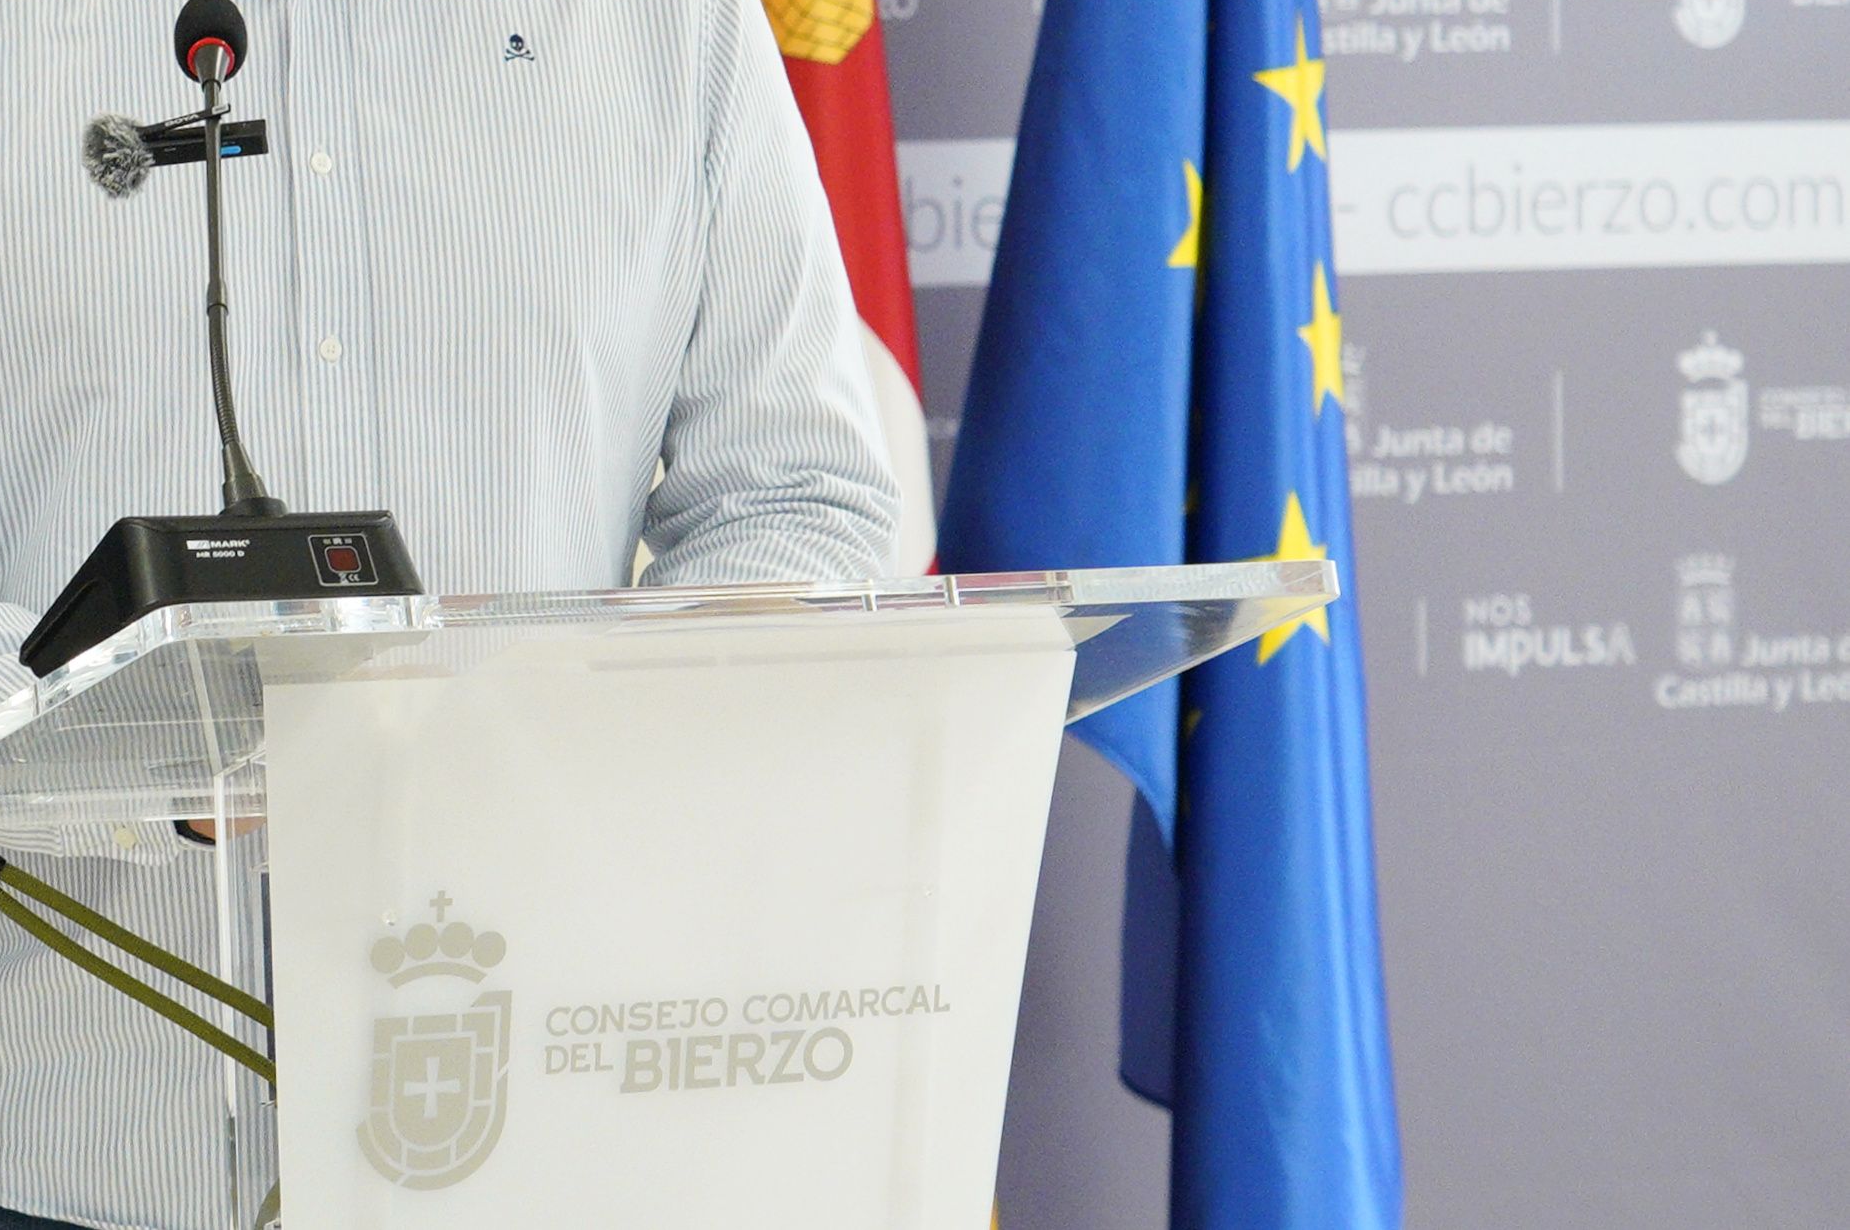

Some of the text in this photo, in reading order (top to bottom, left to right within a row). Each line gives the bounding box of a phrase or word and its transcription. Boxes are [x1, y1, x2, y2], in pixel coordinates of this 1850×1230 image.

[1403, 30, 1424, 62] y
[1431, 22, 1512, 54] León
[1387, 165, 1846, 241] ccbierzo.com
[1375, 424, 1513, 458] Junta de
[1406, 472, 1423, 504] y
[1434, 464, 1515, 495] León
[1656, 672, 1850, 711] Castilla y Leó
[546, 986, 951, 1039] CONSEJO COMARCAL
[545, 1026, 854, 1095] DEL BIERZO
